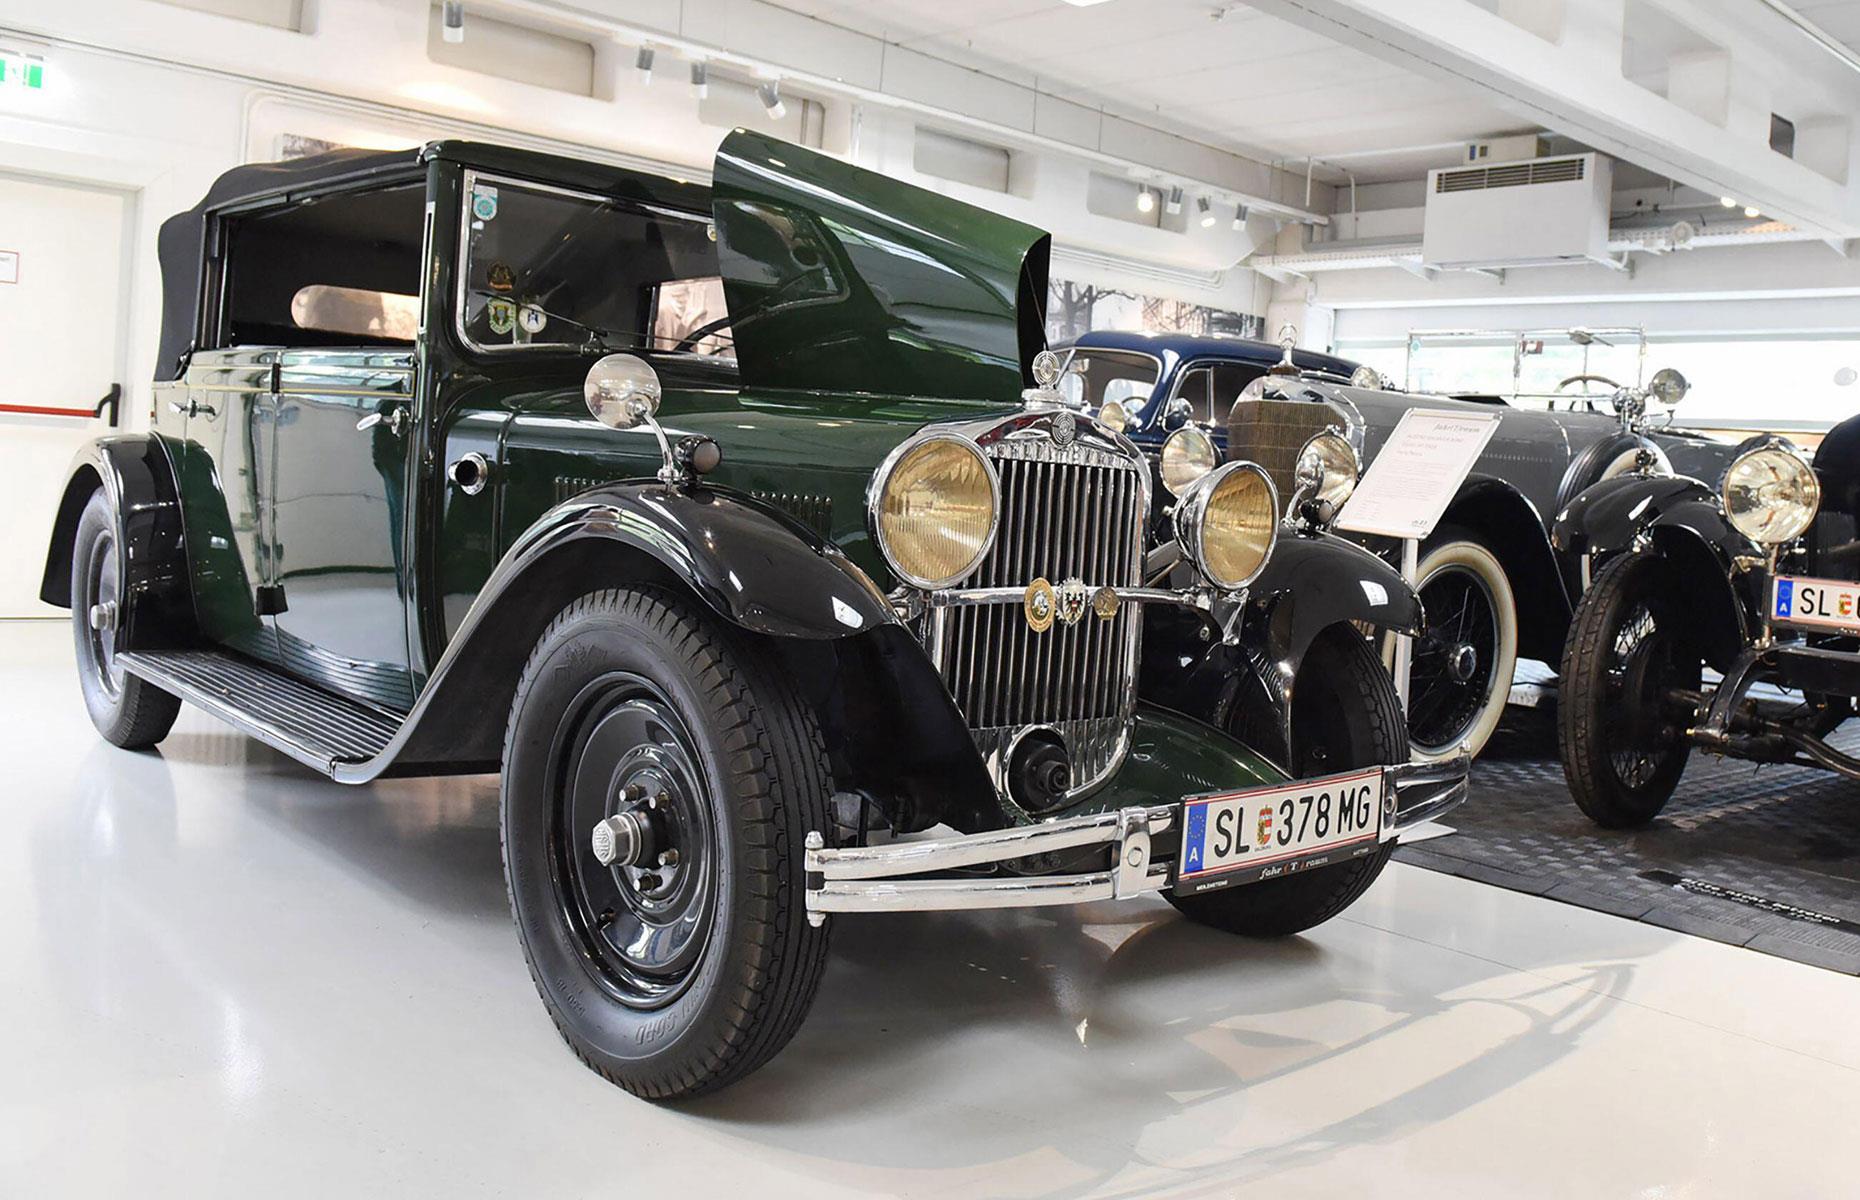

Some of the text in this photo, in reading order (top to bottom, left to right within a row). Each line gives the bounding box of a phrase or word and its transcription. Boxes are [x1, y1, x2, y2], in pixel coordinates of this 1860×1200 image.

[1780, 602, 1788, 612] A
[1800, 588, 1830, 616] SL
[1214, 785, 1370, 858] SL 378 MG
[1189, 847, 1199, 863] A
